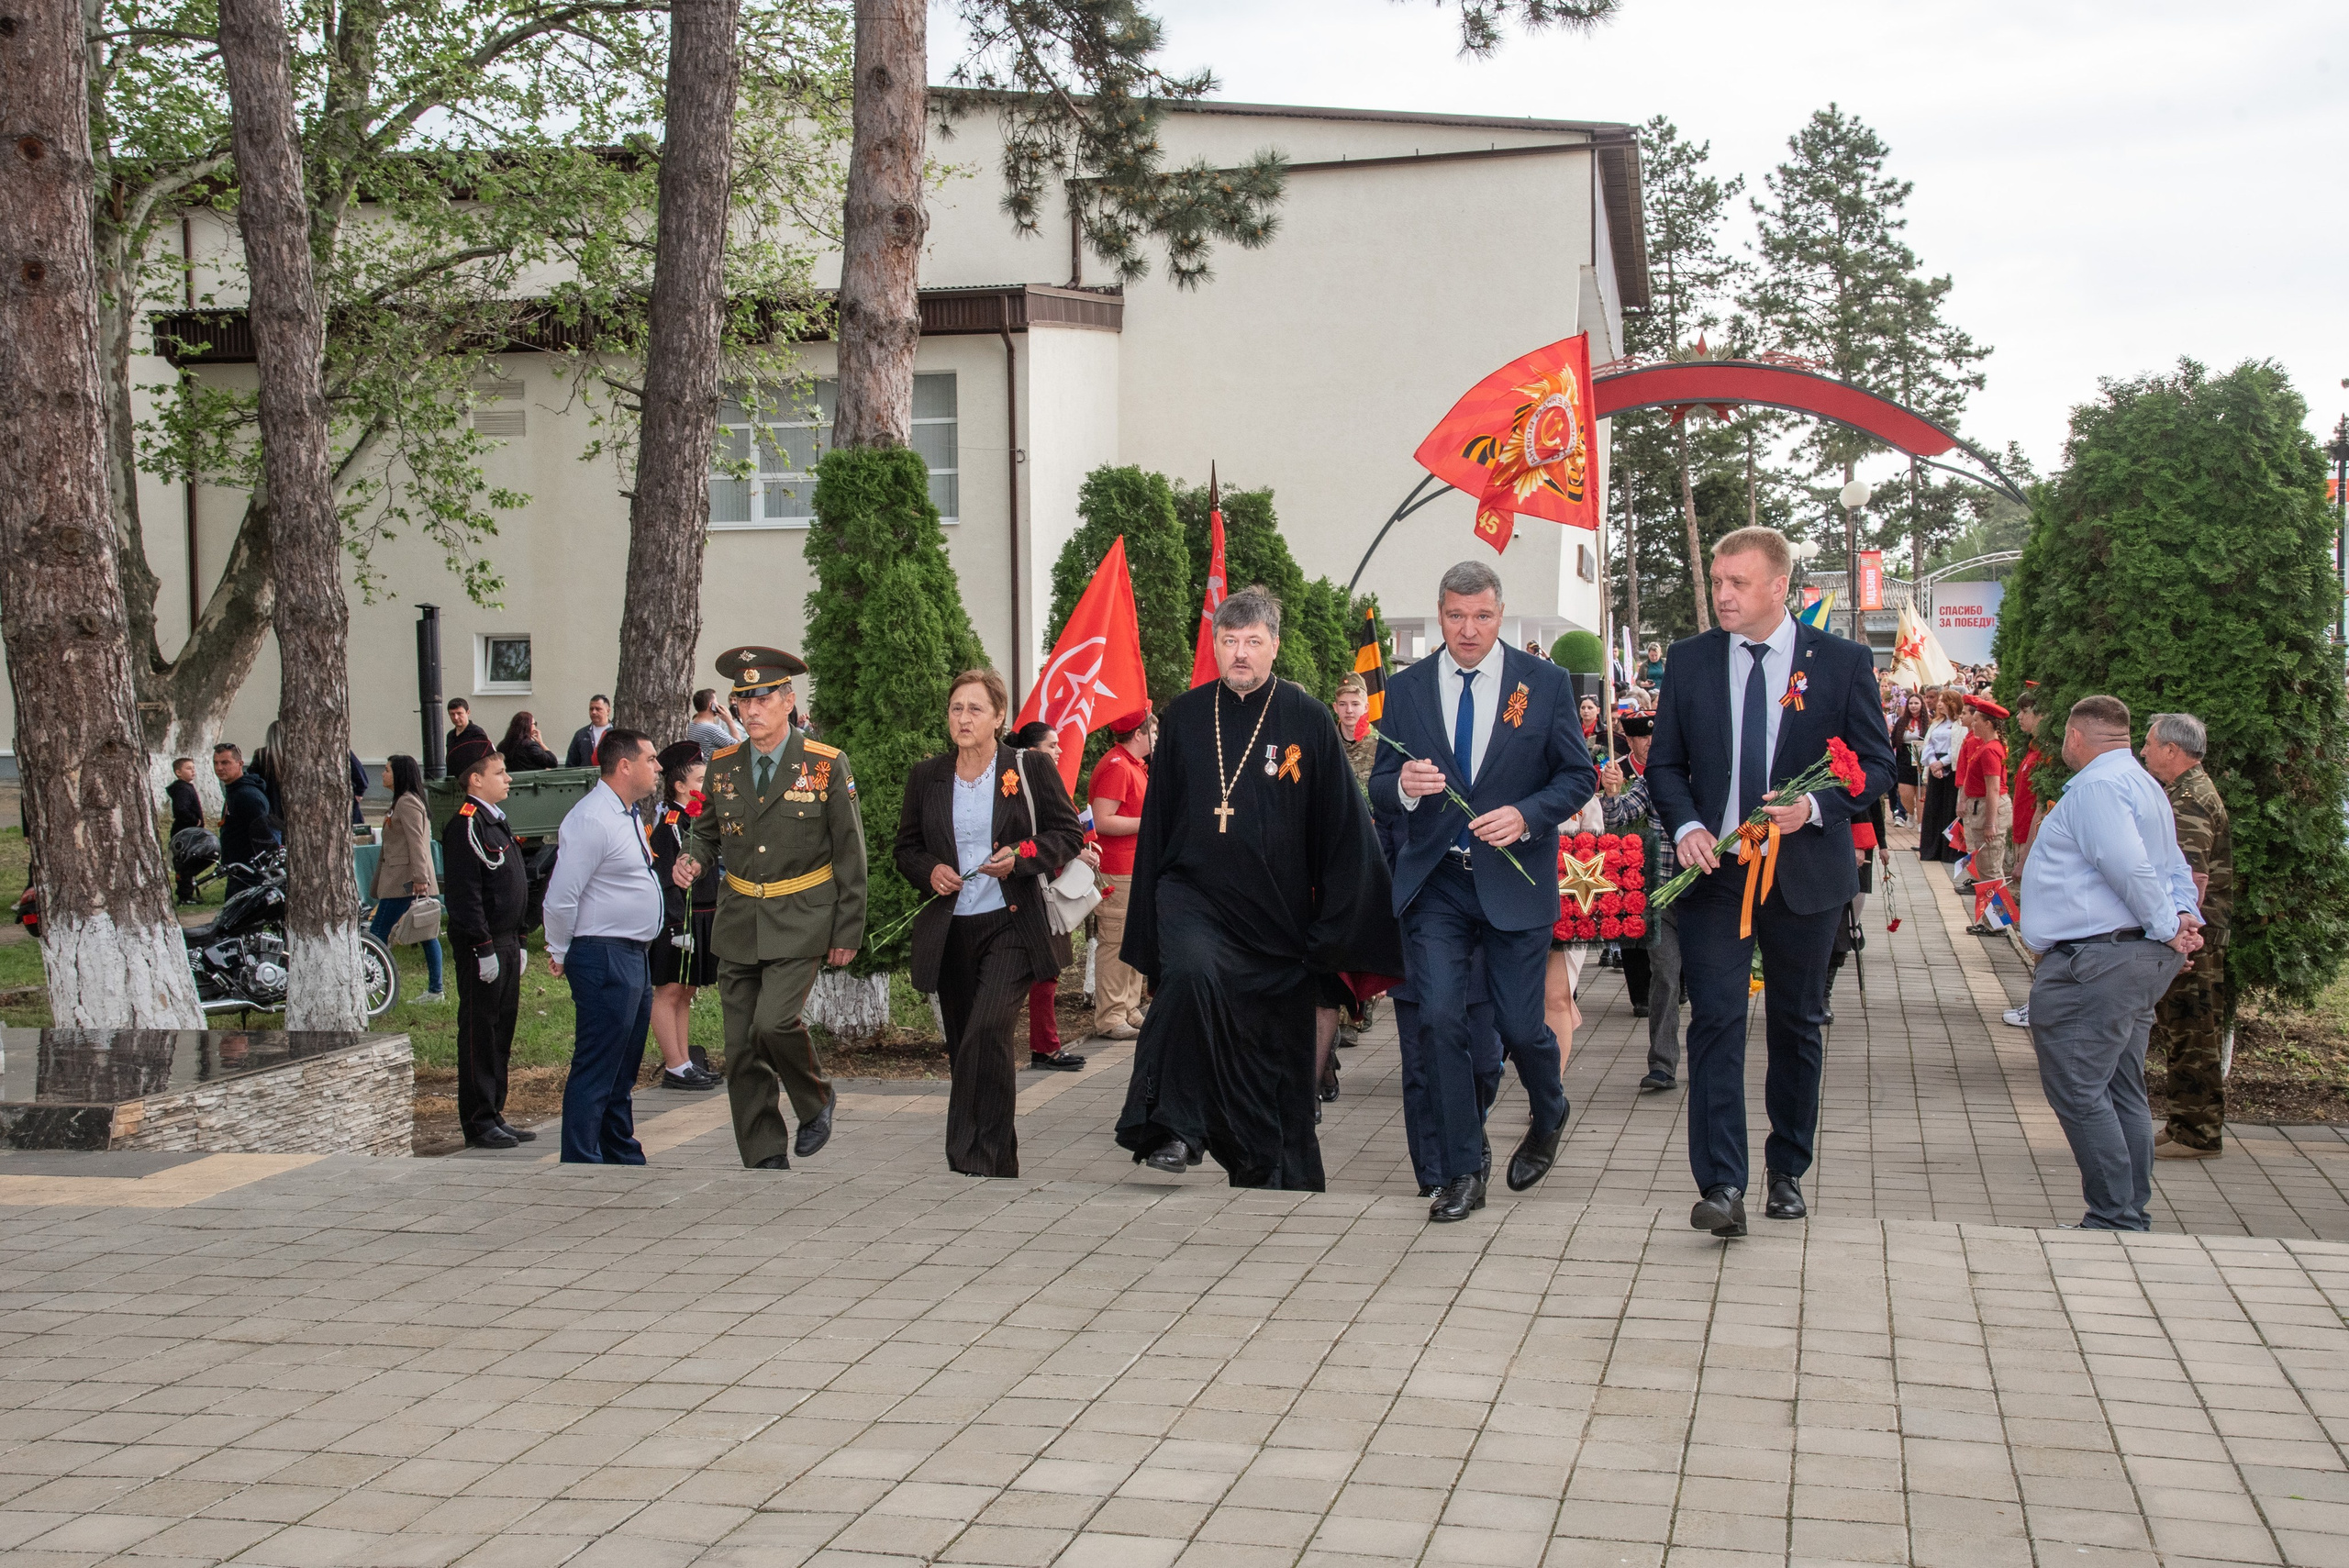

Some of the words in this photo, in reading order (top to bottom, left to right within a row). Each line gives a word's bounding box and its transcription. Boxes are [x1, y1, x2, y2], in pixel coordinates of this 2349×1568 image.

[1866, 569, 1877, 605] ПОБЕДА!
[1939, 606, 1983, 616] СПАСИБО
[1939, 617, 1952, 628] ЗА
[1954, 617, 1995, 628] ПОБЕДУ!
